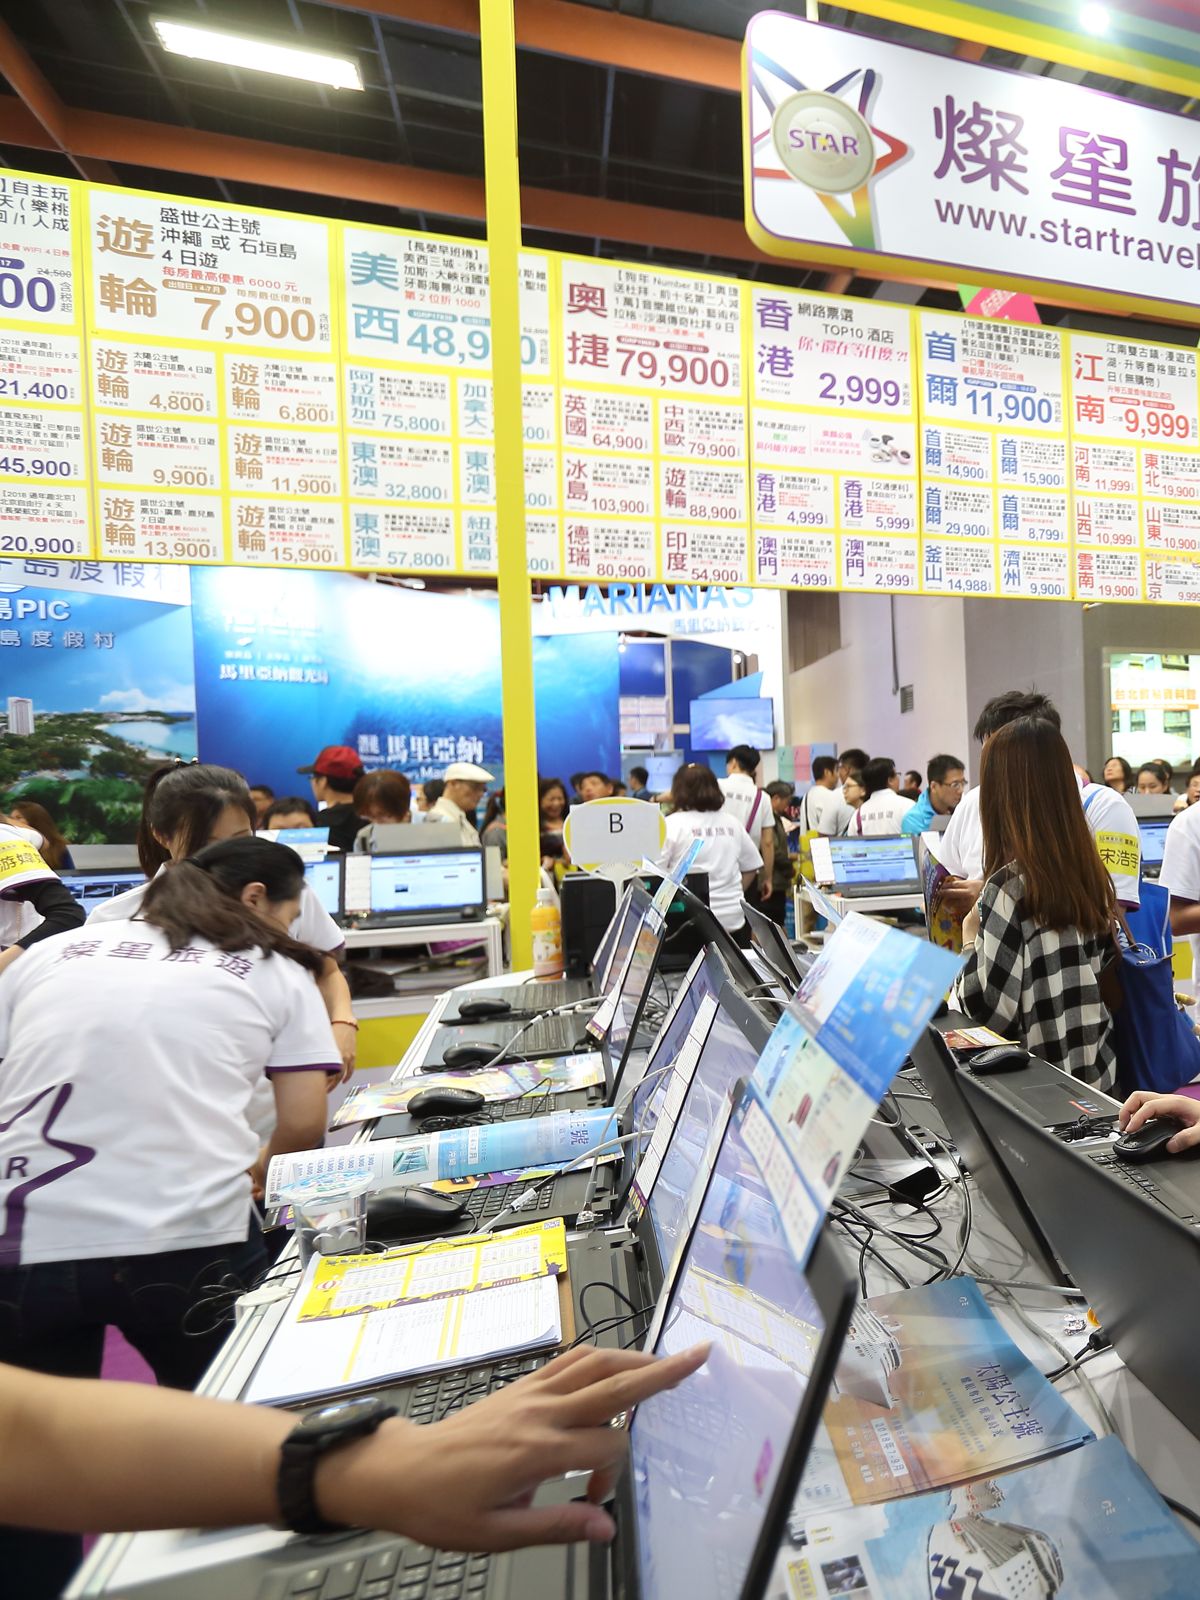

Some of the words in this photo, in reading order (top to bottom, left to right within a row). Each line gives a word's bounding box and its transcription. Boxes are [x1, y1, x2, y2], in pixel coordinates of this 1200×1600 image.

[788, 127, 860, 158] STAR
[160, 206, 262, 236] 盛世公主號
[160, 226, 202, 247] 沖繩
[211, 234, 231, 251] 或
[239, 237, 298, 261] 石垣島
[161, 250, 173, 262] 4
[179, 250, 219, 269] 日遊
[96, 213, 157, 319] 遊輪
[249, 277, 281, 291] 6000
[350, 251, 401, 344] 美西
[194, 297, 316, 342] 7,900
[567, 282, 609, 368] 奧捷
[822, 323, 863, 339] TOP10
[867, 327, 894, 344] 酒店
[756, 298, 794, 378] 香港
[97, 348, 129, 399] 遊輪
[616, 348, 729, 388] 79,900
[925, 330, 958, 407] 首爾
[149, 394, 204, 412] 4,800
[231, 363, 260, 411] 遊輪
[819, 372, 900, 407] 2,999
[1075, 352, 1104, 424] 江南
[279, 405, 328, 422] 6,800
[382, 414, 440, 432] 75,800
[564, 394, 587, 437] 英國
[966, 390, 1052, 423] 11,900
[1124, 408, 1189, 439] 9,999
[593, 433, 643, 450] 64,900
[664, 404, 685, 447] 中西歐
[100, 422, 134, 474] 遊輪
[234, 433, 262, 480] 遊輪
[352, 442, 379, 487] 東澳
[689, 442, 736, 458] 79,900
[925, 429, 942, 467] 首爾
[1001, 438, 1018, 475] 首爾
[1075, 446, 1090, 483] 河南
[0, 457, 71, 476] 45,900
[153, 469, 207, 487] 9,900
[466, 451, 490, 495] 東澳
[566, 459, 588, 502] 冰島
[946, 464, 984, 479] 14,900
[1023, 471, 1061, 486] 15,900
[1144, 453, 1160, 488] 東北
[272, 477, 331, 494] 11,900
[385, 483, 442, 500] 32,800
[665, 467, 687, 509] 遊輪
[757, 473, 776, 513] 香港
[844, 480, 864, 518] 香港
[1095, 479, 1130, 492] 11,999
[1162, 484, 1195, 497] 19,900
[104, 497, 135, 547] 遊輪
[592, 499, 645, 514] 103,900
[690, 505, 737, 520] 88,900
[787, 511, 824, 525] 4,999
[876, 516, 910, 530] 5,999
[925, 487, 942, 525] 首爾
[1002, 494, 1019, 531] 首爾
[1077, 501, 1092, 537] 山西
[237, 506, 265, 552] 遊輪
[354, 513, 381, 558] 東澳
[946, 522, 986, 536] 29,900
[1028, 528, 1060, 541] 8,799
[1096, 533, 1132, 545] 10,999
[1146, 507, 1162, 541] 山東
[1, 535, 74, 554] 20,900
[144, 541, 210, 559] 13,900
[272, 546, 331, 563] 15,900
[387, 551, 445, 568] 57,800
[568, 524, 590, 567] 德瑞
[666, 531, 688, 572] 印度
[758, 536, 778, 576] 澳門
[845, 539, 865, 577] 澳門
[1164, 538, 1197, 550] 10,900
[597, 563, 646, 578] 80,900
[691, 568, 739, 583] 54,900
[791, 573, 828, 587] 4,999
[875, 573, 910, 587] 2,999
[925, 544, 943, 582] 釜山
[1003, 550, 1021, 586] 濟州
[1078, 553, 1094, 589] 雲南
[948, 579, 988, 592] 14,988
[1030, 583, 1061, 595] 9,900
[1099, 585, 1135, 597] 19,900
[1147, 562, 1162, 599] 北京
[609, 812, 624, 834] B
[977, 1362, 1043, 1439] 太陽公主號
